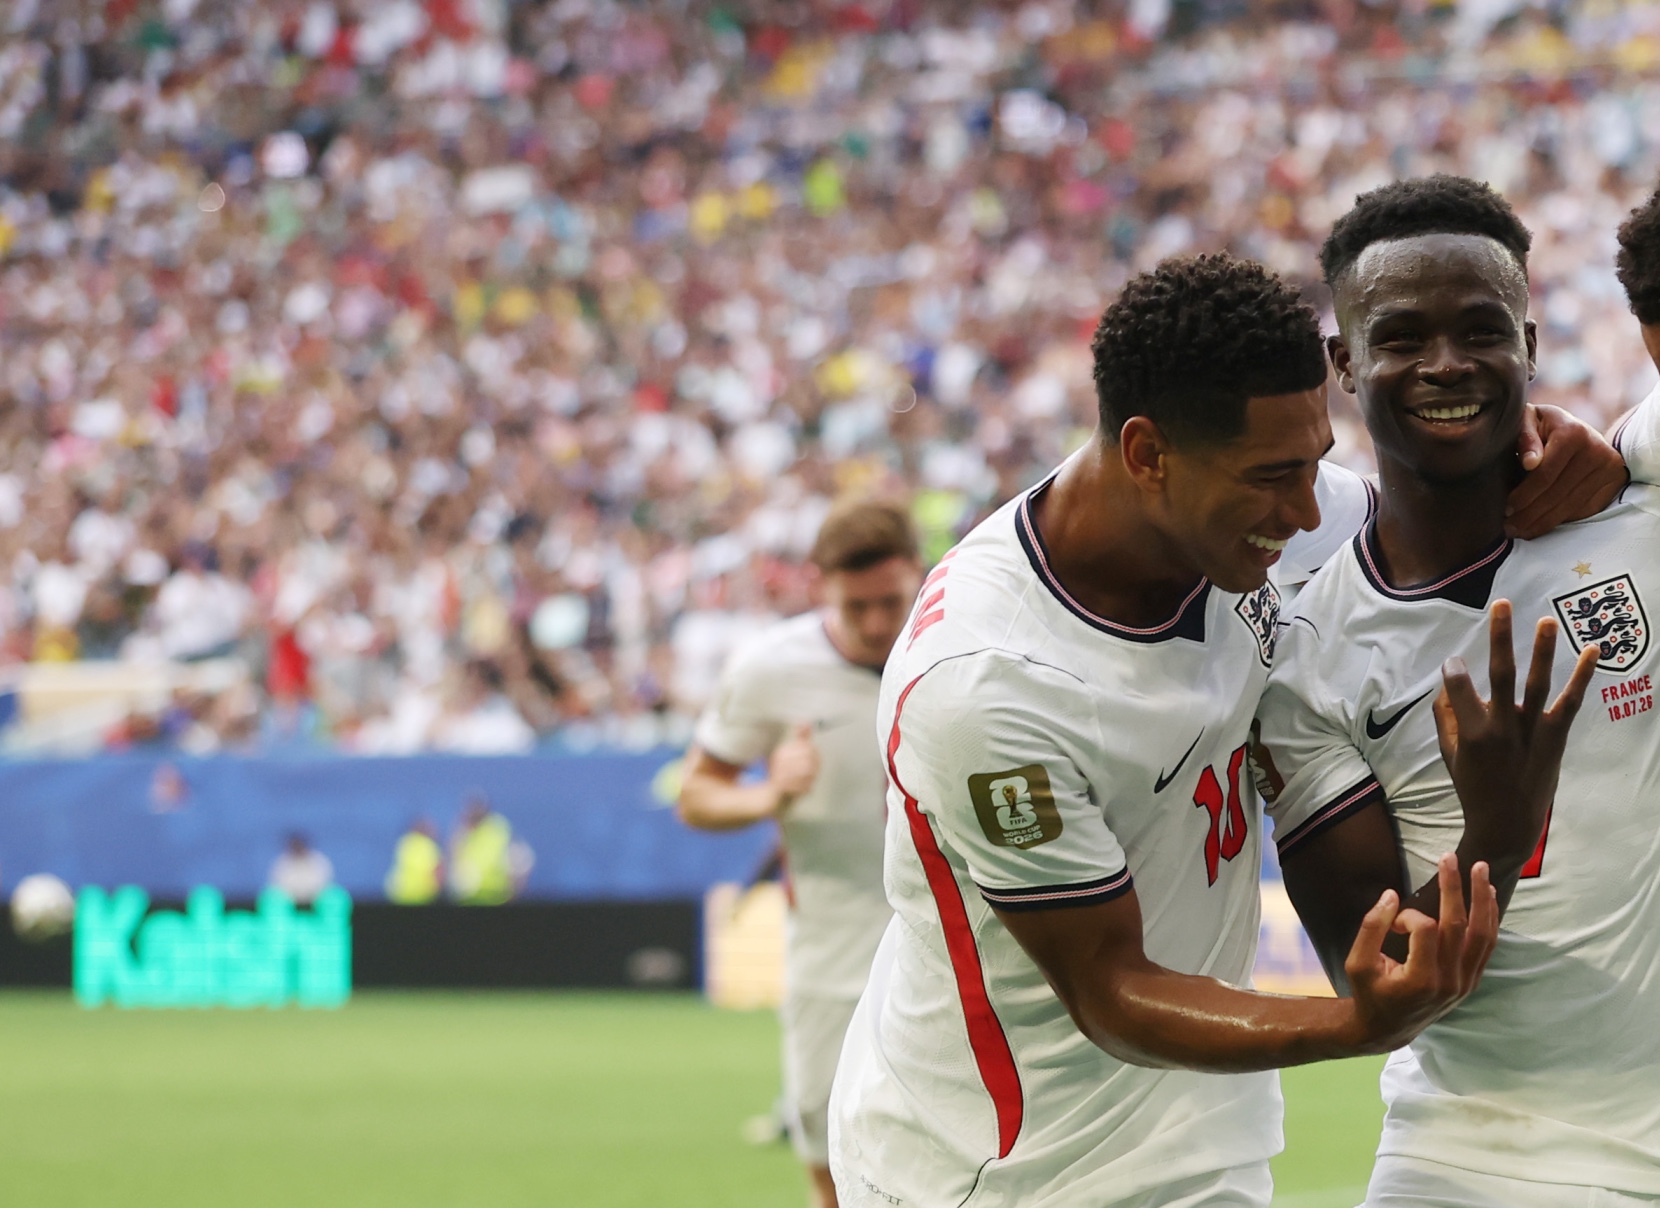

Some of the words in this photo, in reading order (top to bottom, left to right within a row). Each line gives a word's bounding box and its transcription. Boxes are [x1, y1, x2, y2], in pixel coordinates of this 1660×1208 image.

[1601, 674, 1653, 704] FRANCE
[1608, 694, 1653, 722] 18.07.26
[1009, 817, 1028, 826] FIFA
[1192, 741, 1248, 888] 10
[1002, 829, 1027, 838] WORLD
[1027, 824, 1041, 833] CUP
[1005, 830, 1044, 845] 2026
